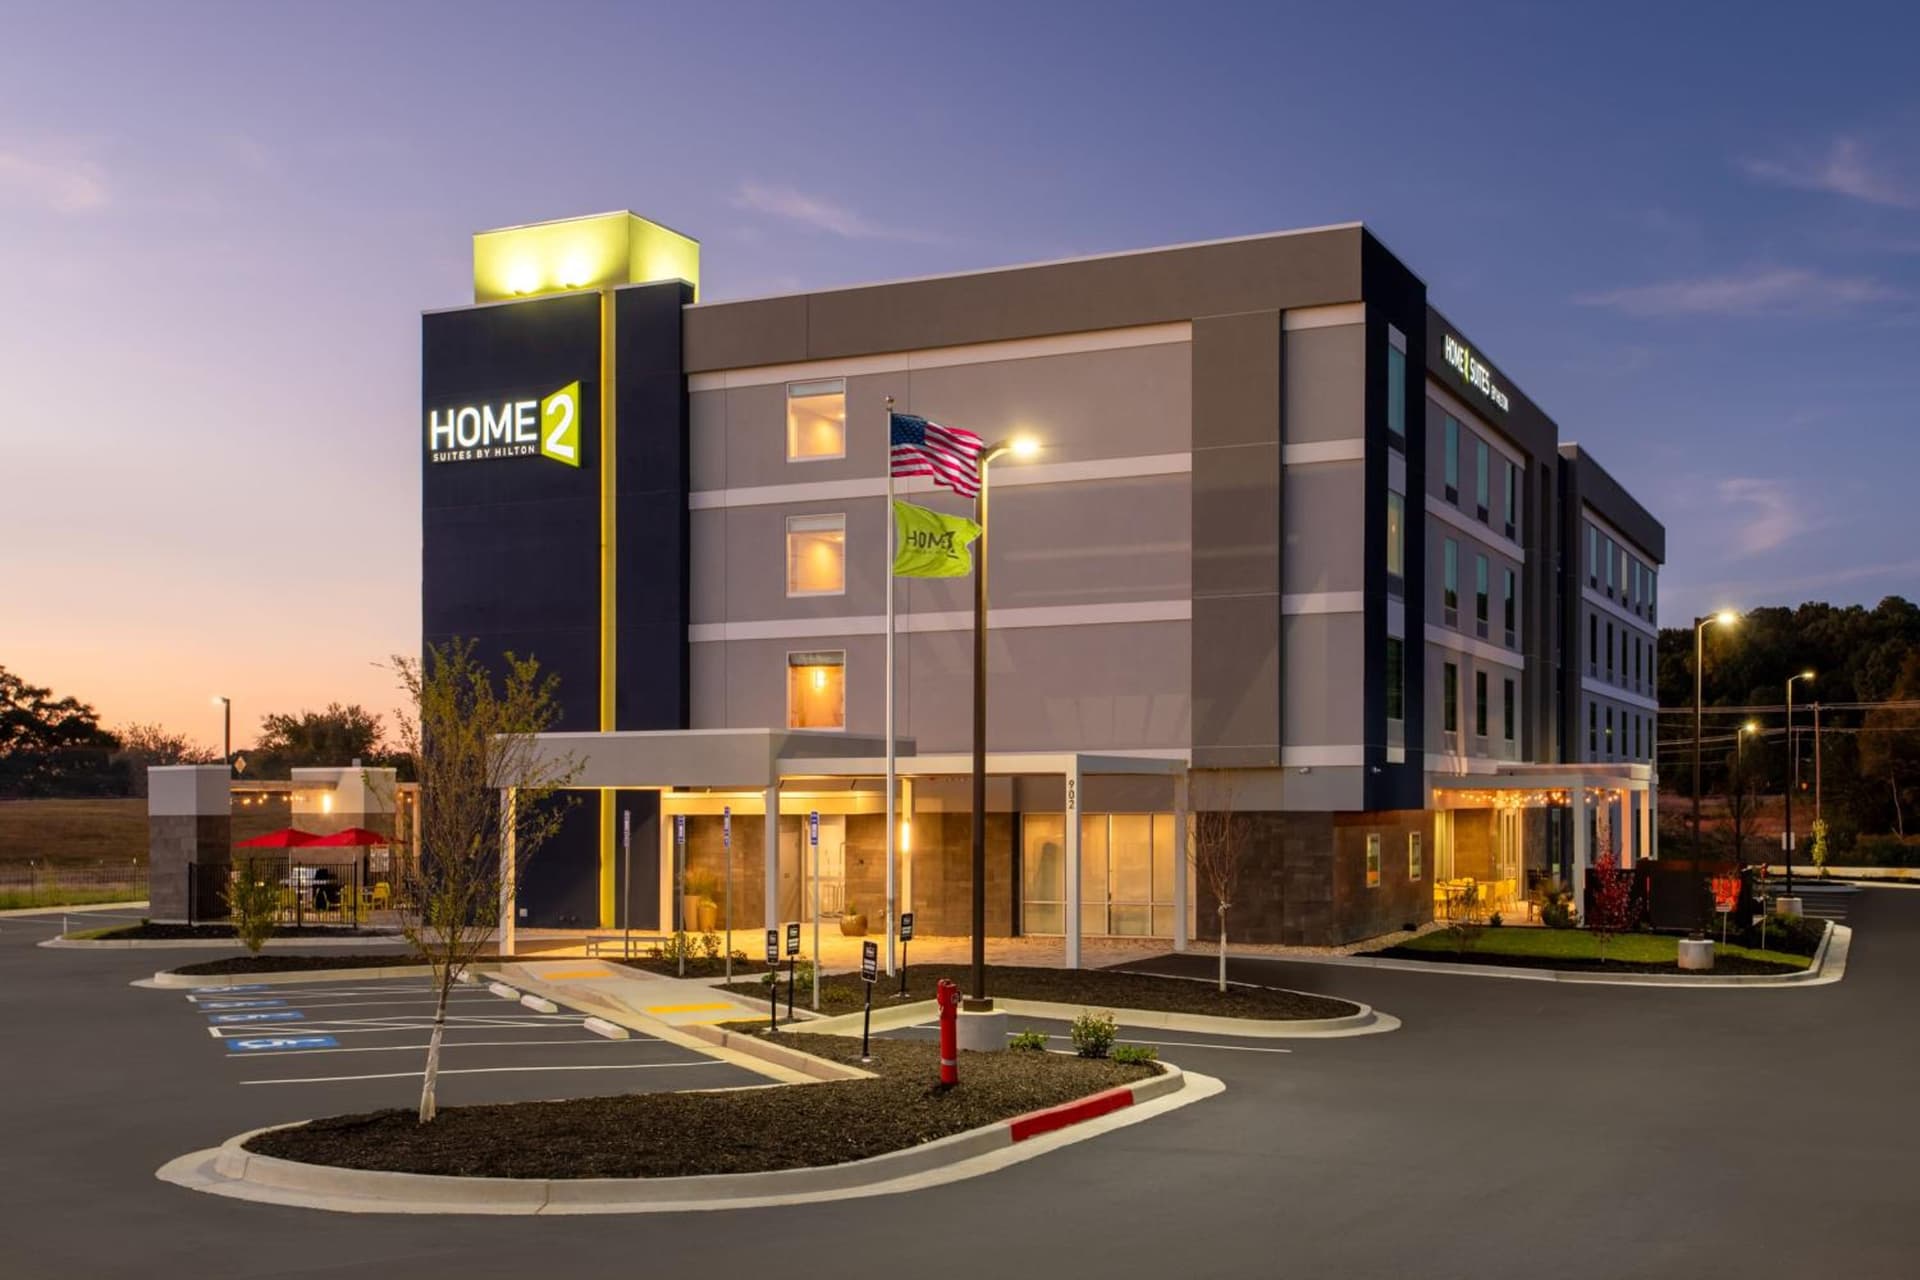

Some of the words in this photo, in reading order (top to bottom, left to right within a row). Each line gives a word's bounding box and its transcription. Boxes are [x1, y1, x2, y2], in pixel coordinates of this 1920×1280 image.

[430, 400, 538, 450] HOME
[546, 393, 575, 459] 2
[432, 450, 472, 462] SUITES
[476, 448, 490, 458] BY
[494, 445, 535, 457] HILTON
